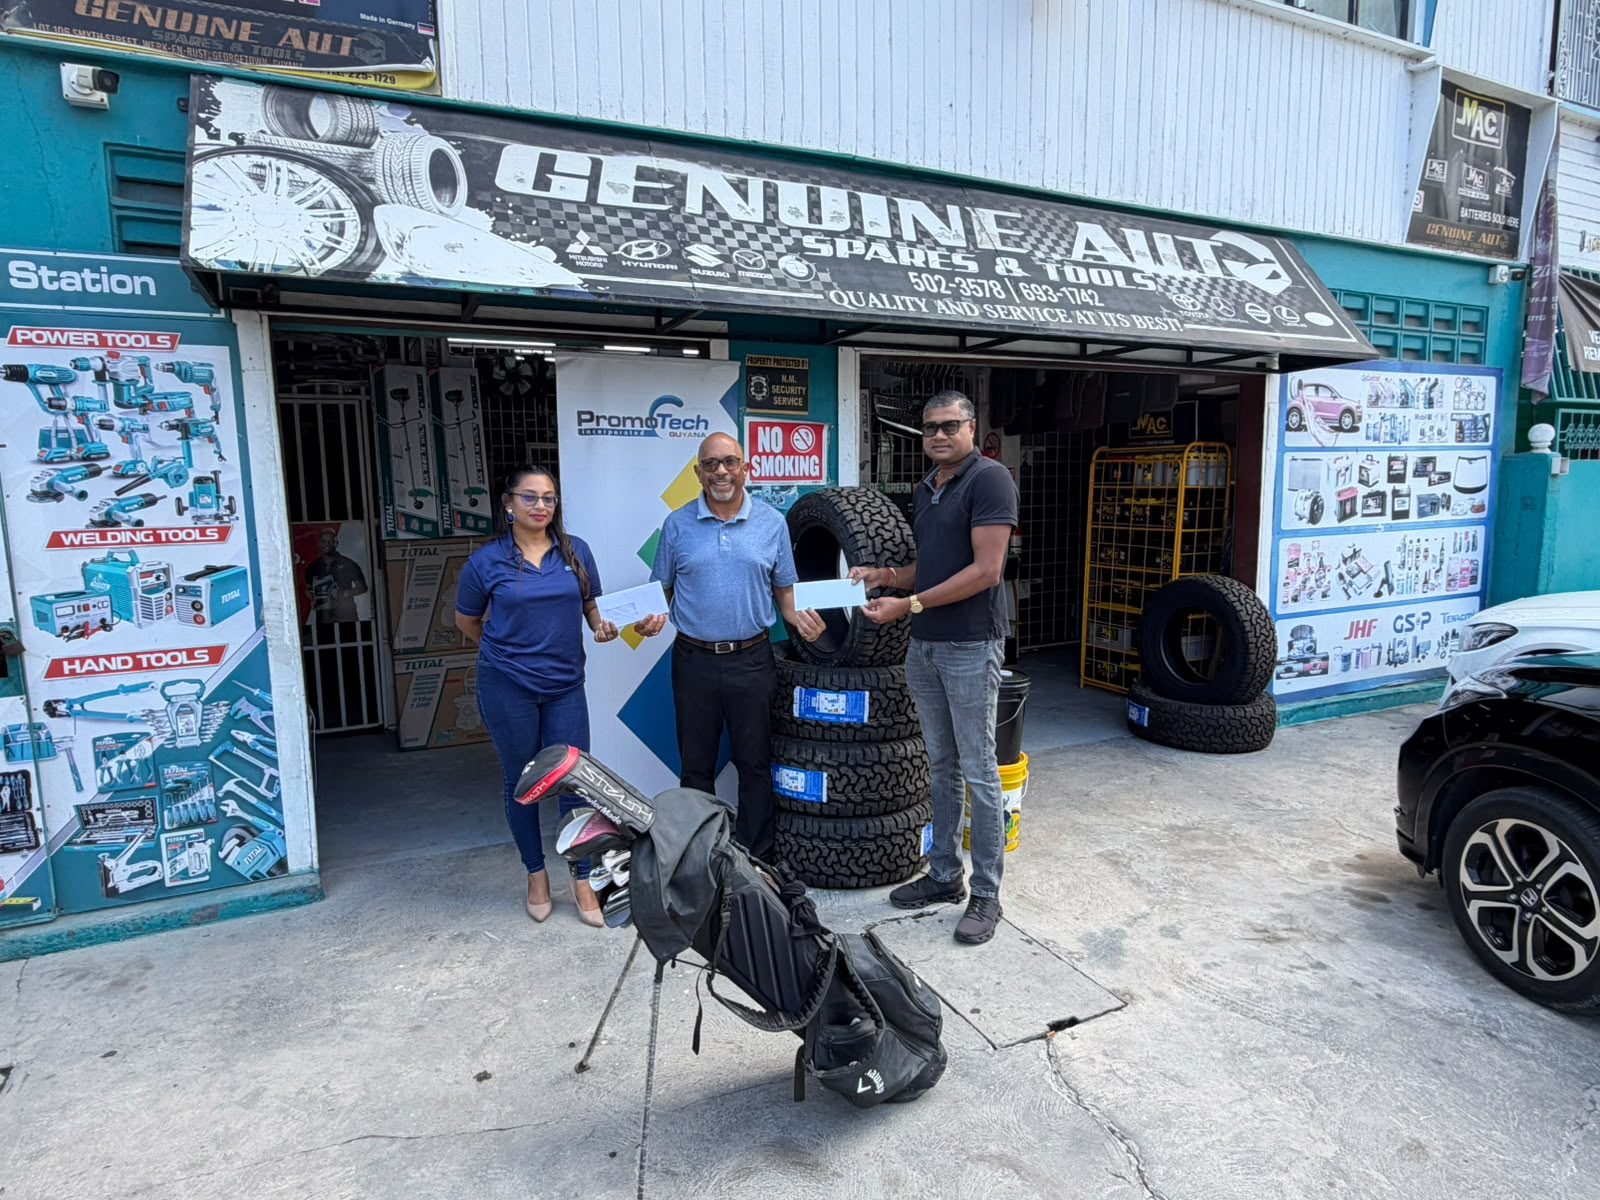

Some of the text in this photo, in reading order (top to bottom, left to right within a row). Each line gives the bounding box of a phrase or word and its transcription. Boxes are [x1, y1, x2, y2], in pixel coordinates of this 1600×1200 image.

[74, 0, 264, 43] GENUINE
[359, 12, 378, 22] Made
[387, 18, 416, 31] Germany
[152, 30, 223, 49] SPARES
[251, 45, 305, 62] TOOLS
[1456, 96, 1499, 143] MAC
[1466, 168, 1484, 188] MAC
[495, 143, 1030, 254] GENUINE
[1460, 207, 1520, 228] BATTERIES SOLD HERE
[1426, 223, 1476, 241] GENUINE
[568, 254, 608, 264] MITSUBISHI
[622, 260, 678, 271] HYUNDAI
[802, 235, 1157, 291] SPARES & TOOLS
[7, 260, 157, 296] Station
[690, 268, 730, 278] SUZUKI
[908, 271, 1006, 300] 502-3578
[1019, 282, 1105, 307] 693-1742
[829, 288, 1184, 333] QUALITY AND SERVICE AT ITS BEST!
[1179, 310, 1209, 319] TOYOTA
[15, 329, 172, 348] POWER TOOLS
[781, 374, 796, 383] N.M.
[771, 385, 807, 395] SECURITY
[773, 396, 803, 406] SERVICE
[577, 410, 709, 430] PromoTech
[1131, 413, 1170, 434] MAC
[758, 426, 783, 452] NO
[751, 455, 820, 477] SMOKING
[385, 505, 395, 531] TOTAL
[441, 503, 451, 529] TOTAL
[60, 527, 219, 546] WELDING TOOLS
[400, 547, 440, 557] TOTAL
[221, 589, 241, 604] TOTAL
[1344, 619, 1378, 640] JHF
[62, 650, 210, 675] HAND TOOLS
[403, 659, 444, 670] TOTAL
[164, 767, 189, 775] TOTAL
[245, 845, 264, 865] TOTAL
